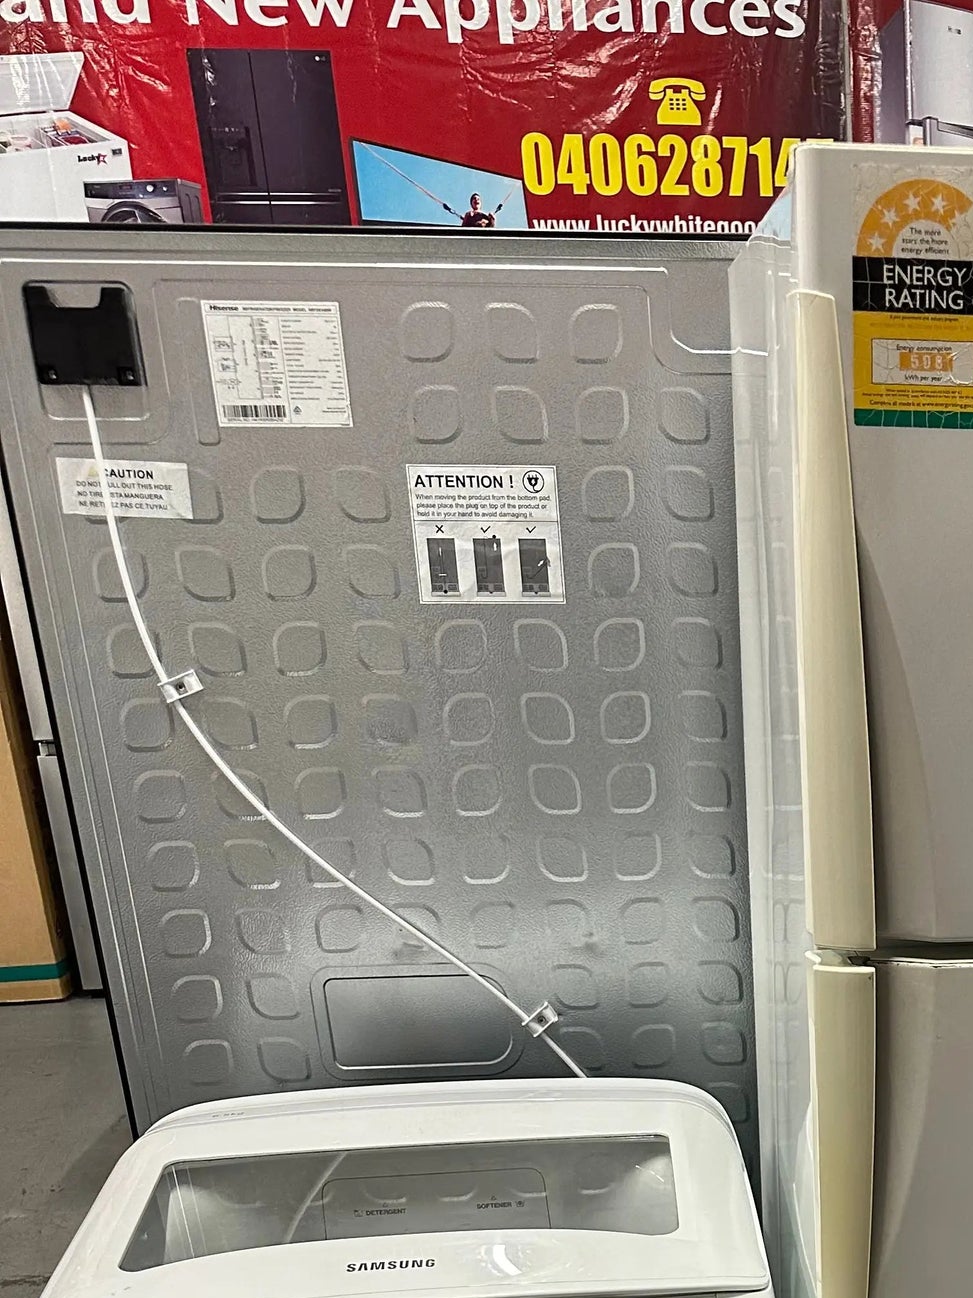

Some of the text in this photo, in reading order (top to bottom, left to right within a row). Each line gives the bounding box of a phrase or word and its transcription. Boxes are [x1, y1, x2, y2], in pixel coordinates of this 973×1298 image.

[386, 0, 807, 45] Appliances
[521, 131, 834, 198] 040628714
[910, 227, 922, 235] The
[882, 264, 967, 287] ENERGY
[885, 288, 964, 310] RATING
[414, 474, 504, 489] ATTENTION
[434, 494, 456, 502] moving
[468, 494, 491, 502] product
[489, 503, 499, 511] top
[517, 503, 540, 511] product
[365, 1208, 406, 1216] DETERGENT
[476, 1202, 513, 1210] SOFTENER
[346, 1258, 436, 1273] SAMSUNG
